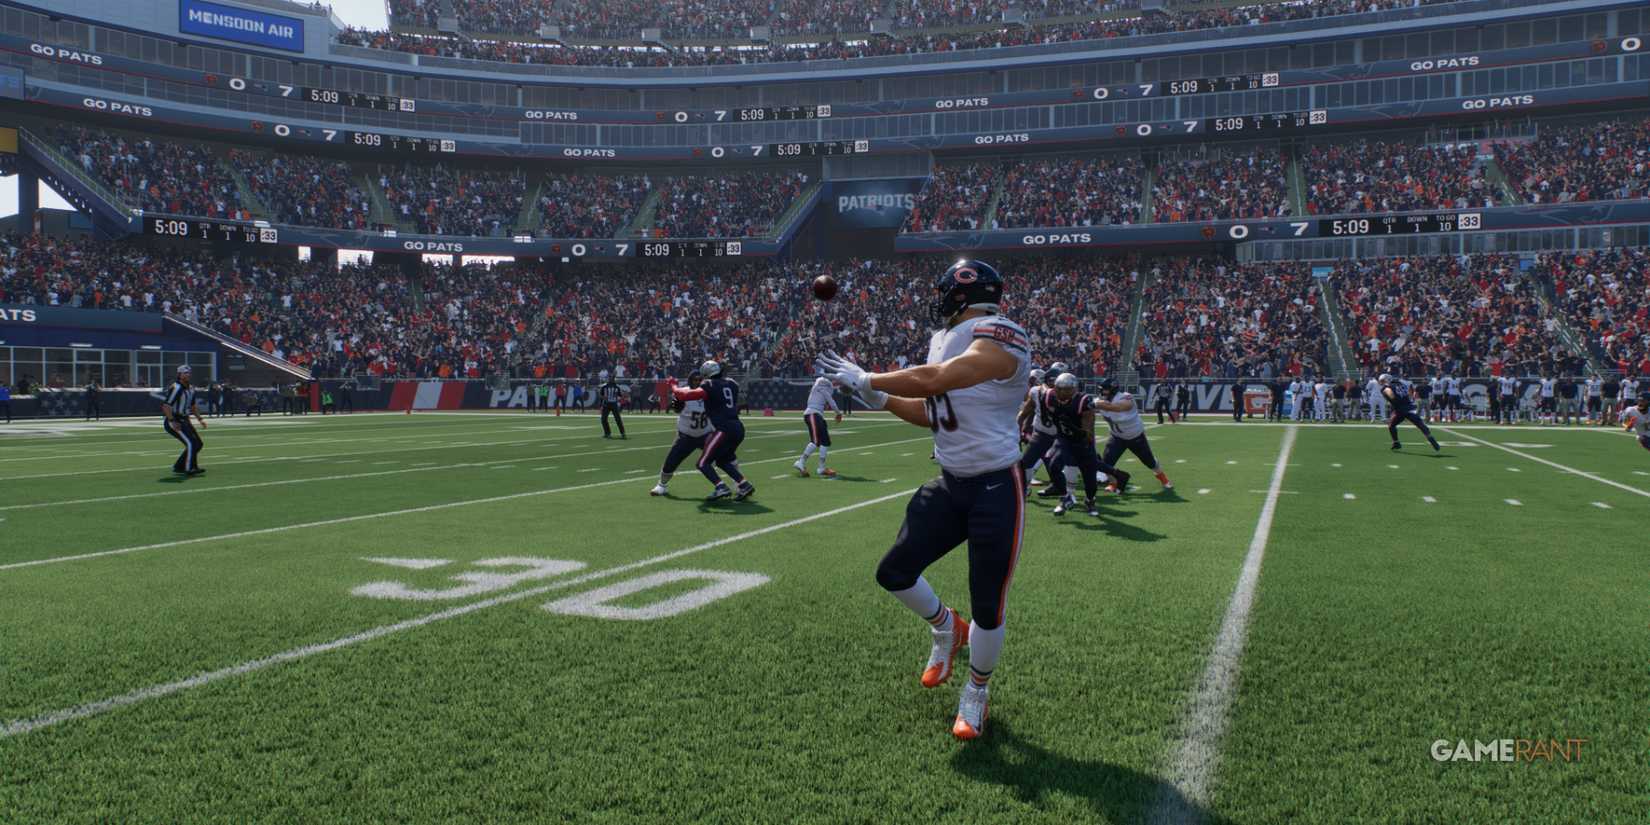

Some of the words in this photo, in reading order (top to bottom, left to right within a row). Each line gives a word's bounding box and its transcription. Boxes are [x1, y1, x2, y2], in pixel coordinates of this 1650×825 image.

[268, 24, 294, 38] AIR
[1621, 38, 1640, 51] 0
[30, 44, 54, 56] GO
[58, 49, 102, 64] PATS
[1411, 61, 1433, 71] GO
[1437, 56, 1480, 68] PATS
[229, 78, 246, 90] 0
[278, 85, 293, 97] 7
[311, 90, 338, 103] 5:09
[1094, 87, 1108, 99] 0
[1139, 84, 1153, 96] 7
[1170, 80, 1198, 94] 5:09
[83, 98, 106, 109] GO
[112, 102, 152, 116] PATS
[935, 100, 953, 108] GO
[956, 97, 988, 107] PATS
[1462, 100, 1486, 110] GO
[1490, 95, 1534, 107] PATS
[525, 111, 543, 119] GO
[546, 112, 577, 120] PATS
[675, 112, 688, 122] 0
[714, 110, 727, 121] 7
[741, 109, 764, 121] 5:09
[1137, 124, 1152, 136] 0
[1183, 121, 1198, 133] 7
[1215, 118, 1243, 131] 5:09
[275, 124, 290, 136] 0
[323, 130, 336, 141] 7
[354, 133, 381, 146] 5:09
[975, 136, 992, 144] GO
[996, 133, 1029, 143] PATS
[564, 148, 581, 156] GO
[584, 149, 616, 157] PATS
[712, 147, 724, 158] 0
[751, 146, 763, 156] 7
[778, 144, 800, 155] 5:09
[839, 193, 914, 213] PATRIOTS
[155, 220, 188, 236] 5:09
[202, 229, 207, 238] 1
[226, 232, 230, 240] 1
[246, 233, 256, 242] 10
[1229, 225, 1248, 238] 0
[1290, 222, 1309, 236] 7
[1332, 220, 1369, 235] 5:09
[1387, 224, 1392, 233] 1
[1415, 224, 1420, 232] 1
[1440, 222, 1451, 232] 10
[404, 241, 424, 250] GO
[427, 242, 463, 252] PATS
[1023, 235, 1046, 245] GO
[1050, 233, 1091, 244] PATS
[572, 244, 586, 256] 0
[616, 244, 629, 256] 7
[644, 244, 669, 256] 5:09
[681, 248, 684, 256] 1
[699, 248, 702, 256] 1
[715, 248, 723, 256] 10
[722, 387, 734, 408] 9
